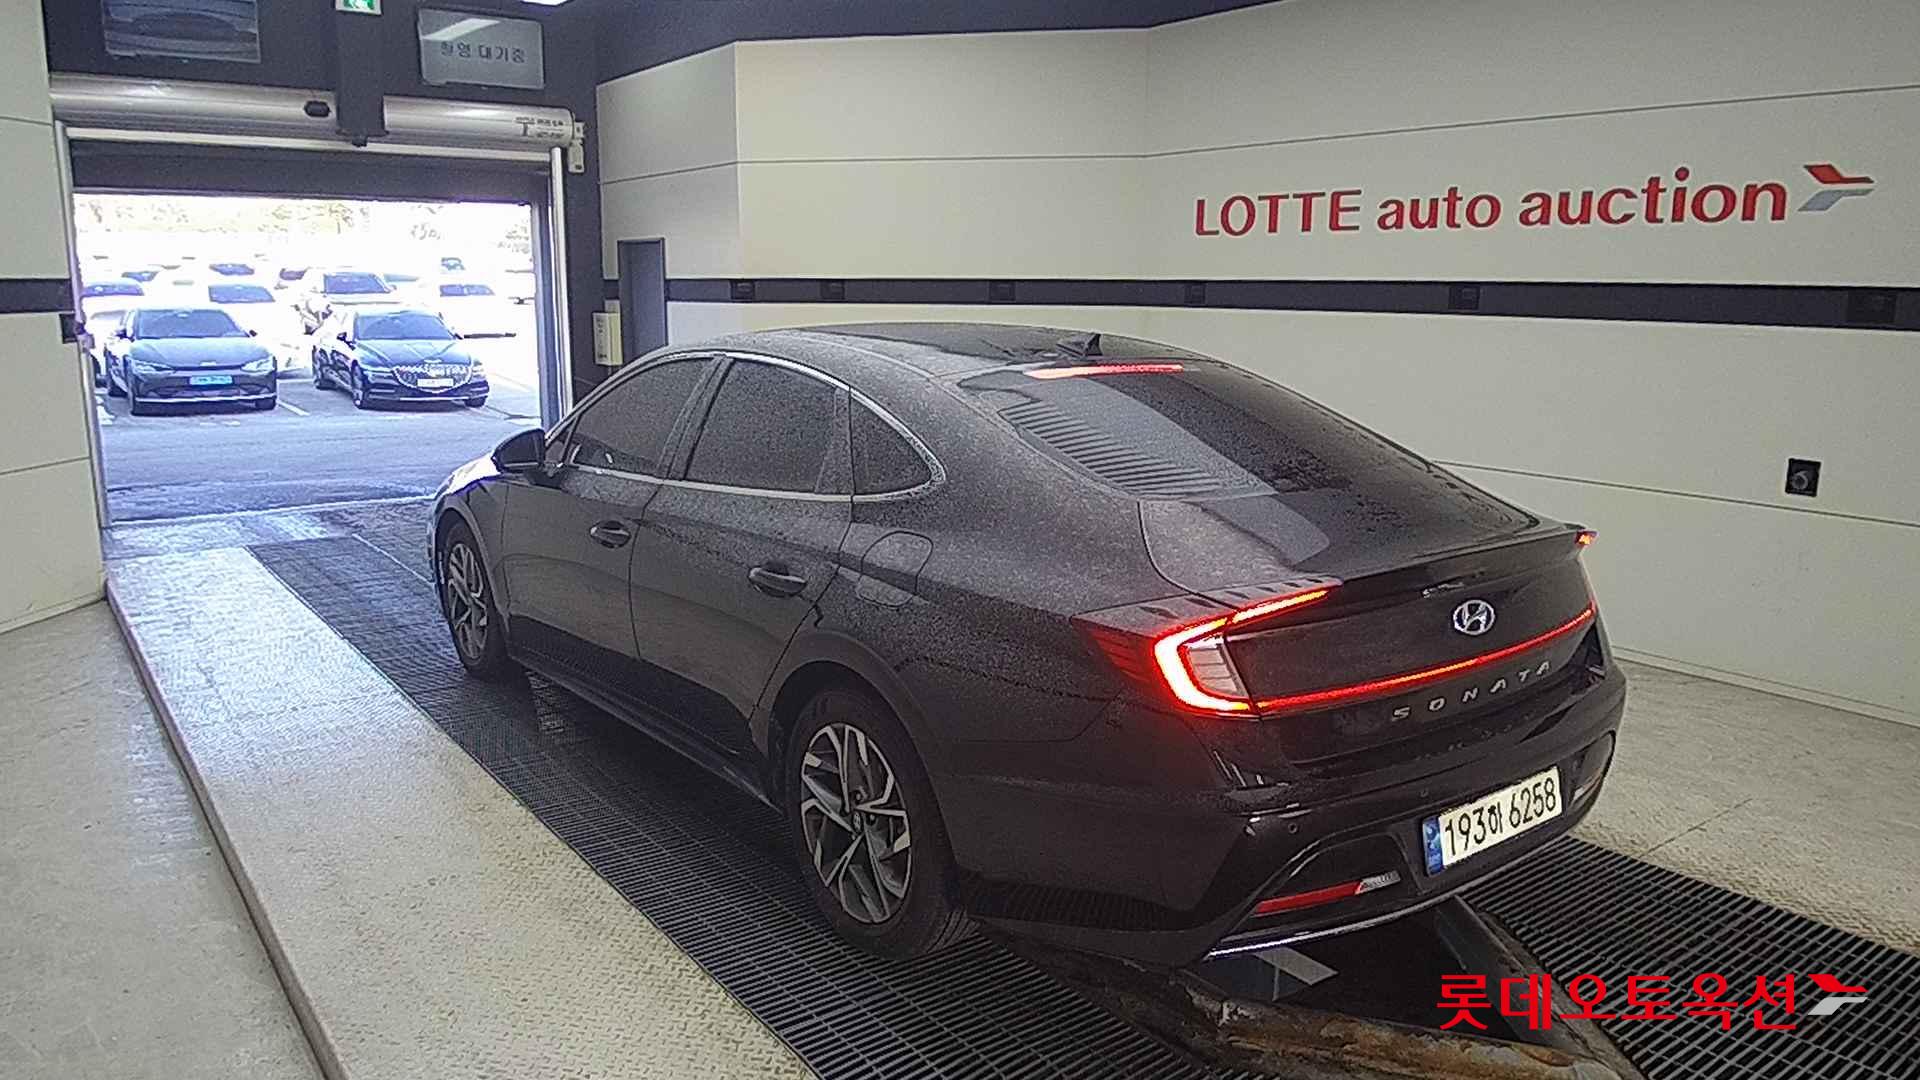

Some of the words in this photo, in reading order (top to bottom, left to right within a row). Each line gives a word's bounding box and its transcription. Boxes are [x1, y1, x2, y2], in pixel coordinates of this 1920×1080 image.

[1195, 189, 1362, 237] LOTTE
[1378, 186, 1502, 230] auto
[1519, 167, 1788, 226] auction
[1391, 660, 1551, 723] SONATA
[1508, 776, 1557, 829] 6258
